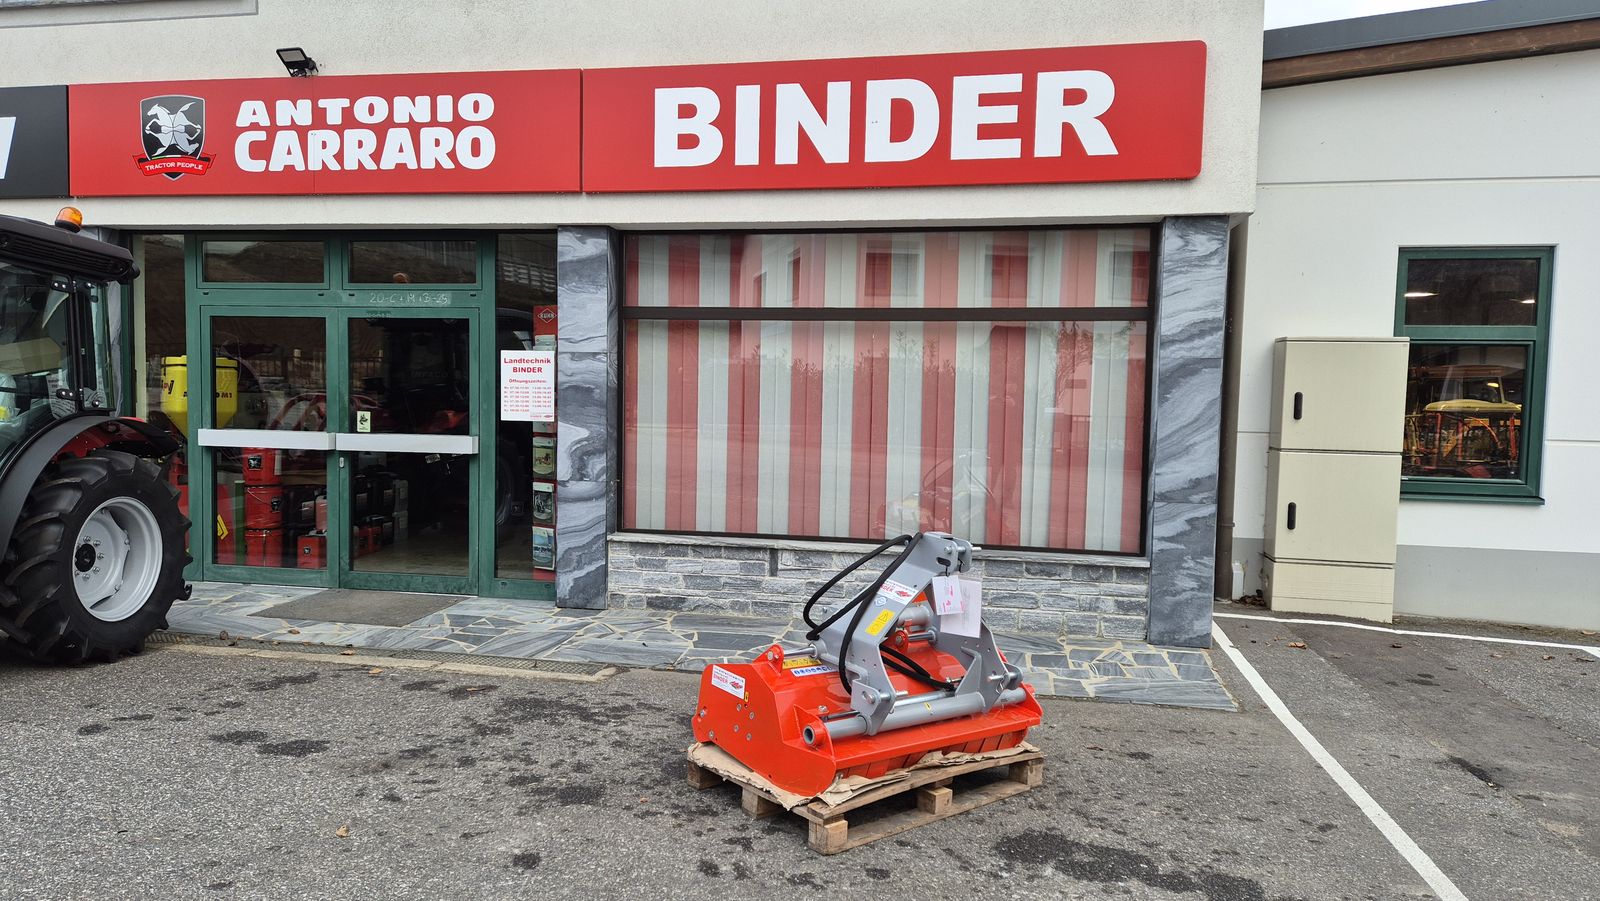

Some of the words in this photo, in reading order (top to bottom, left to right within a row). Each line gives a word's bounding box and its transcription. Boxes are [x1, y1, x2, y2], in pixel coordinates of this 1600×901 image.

[235, 92, 496, 127] ANTONIO
[654, 69, 1119, 168] BINDER
[145, 162, 175, 171] TRACTOR
[176, 161, 203, 170] PEOPLE
[234, 126, 497, 173] CARRARO
